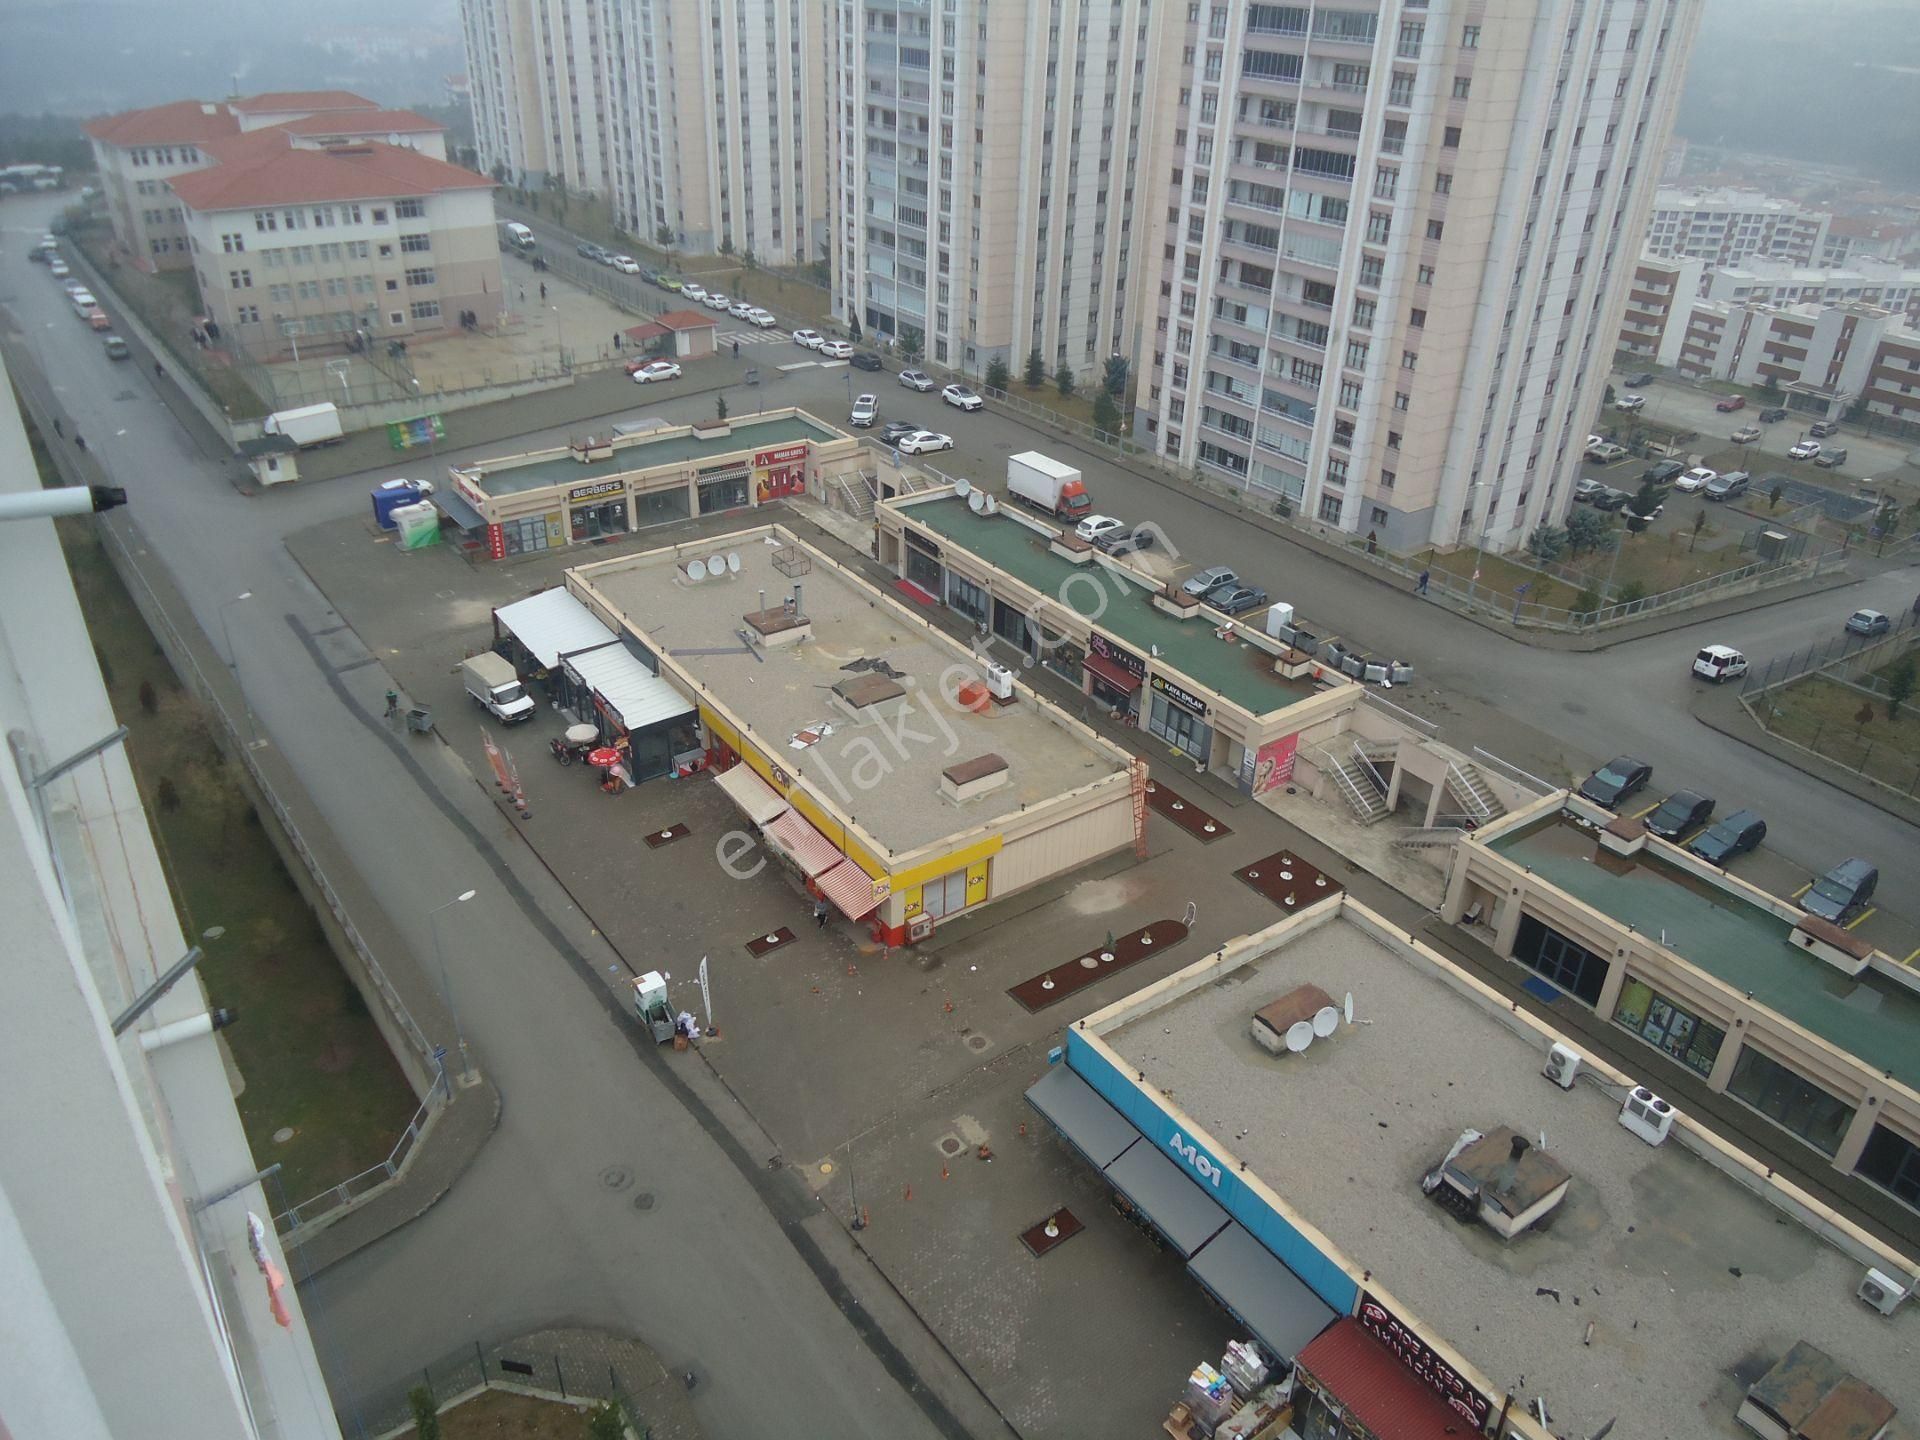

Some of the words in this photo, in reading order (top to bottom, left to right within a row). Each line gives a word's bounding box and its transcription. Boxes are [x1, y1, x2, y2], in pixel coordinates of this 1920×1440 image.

[1164, 683, 1181, 698] KAYA
[1181, 692, 1204, 710] EMLAK
[1362, 1314, 1444, 1393] LAHMACUN
